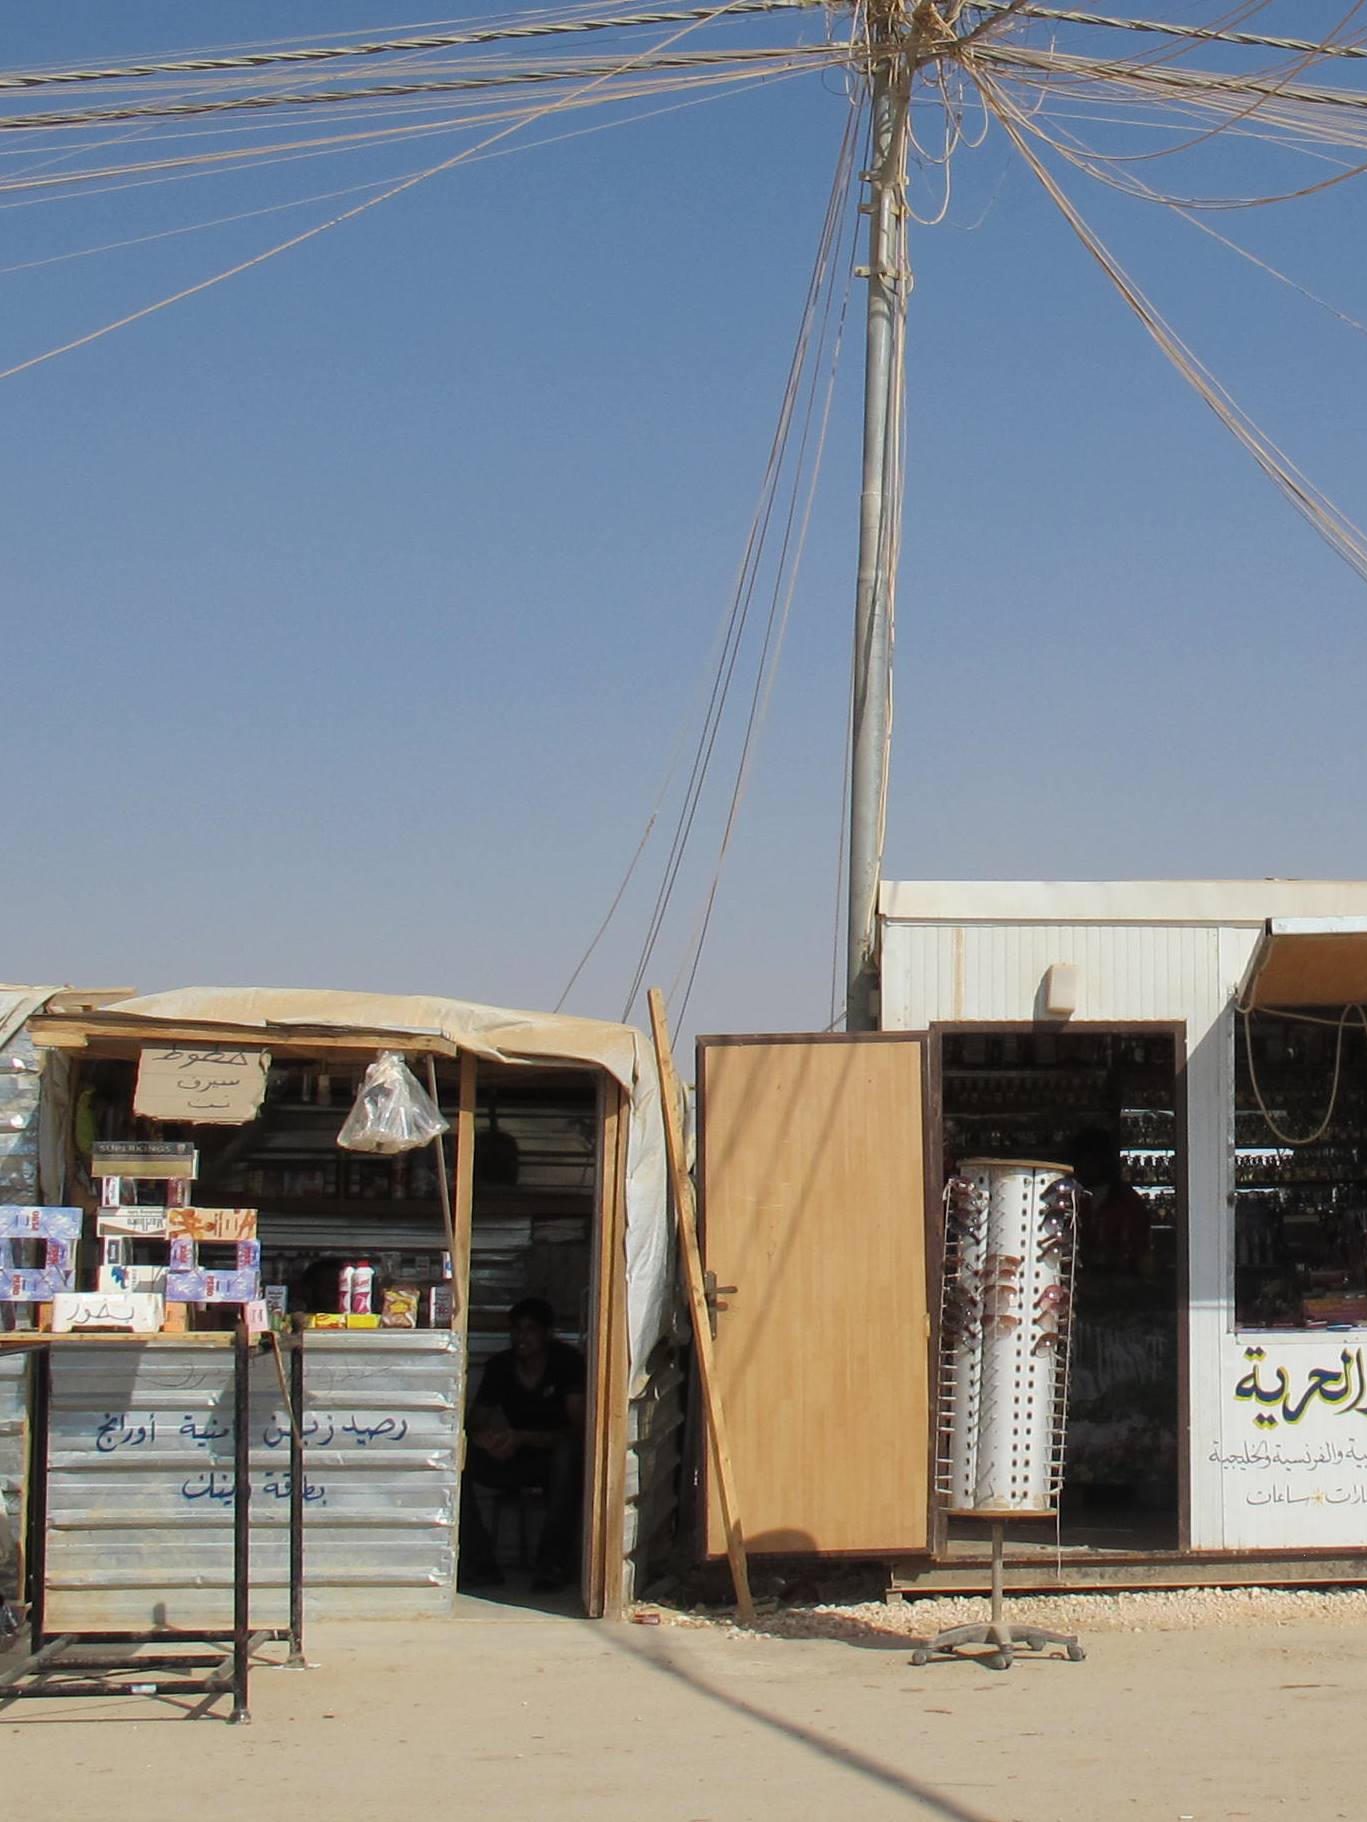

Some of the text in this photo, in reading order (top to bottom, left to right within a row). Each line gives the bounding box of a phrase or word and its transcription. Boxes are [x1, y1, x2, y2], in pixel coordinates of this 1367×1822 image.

[1234, 1345, 1367, 1428] الحرية
[180, 1414, 236, 1447] منية
[342, 1414, 407, 1446] رصيد
[263, 1471, 328, 1505] بطقة
